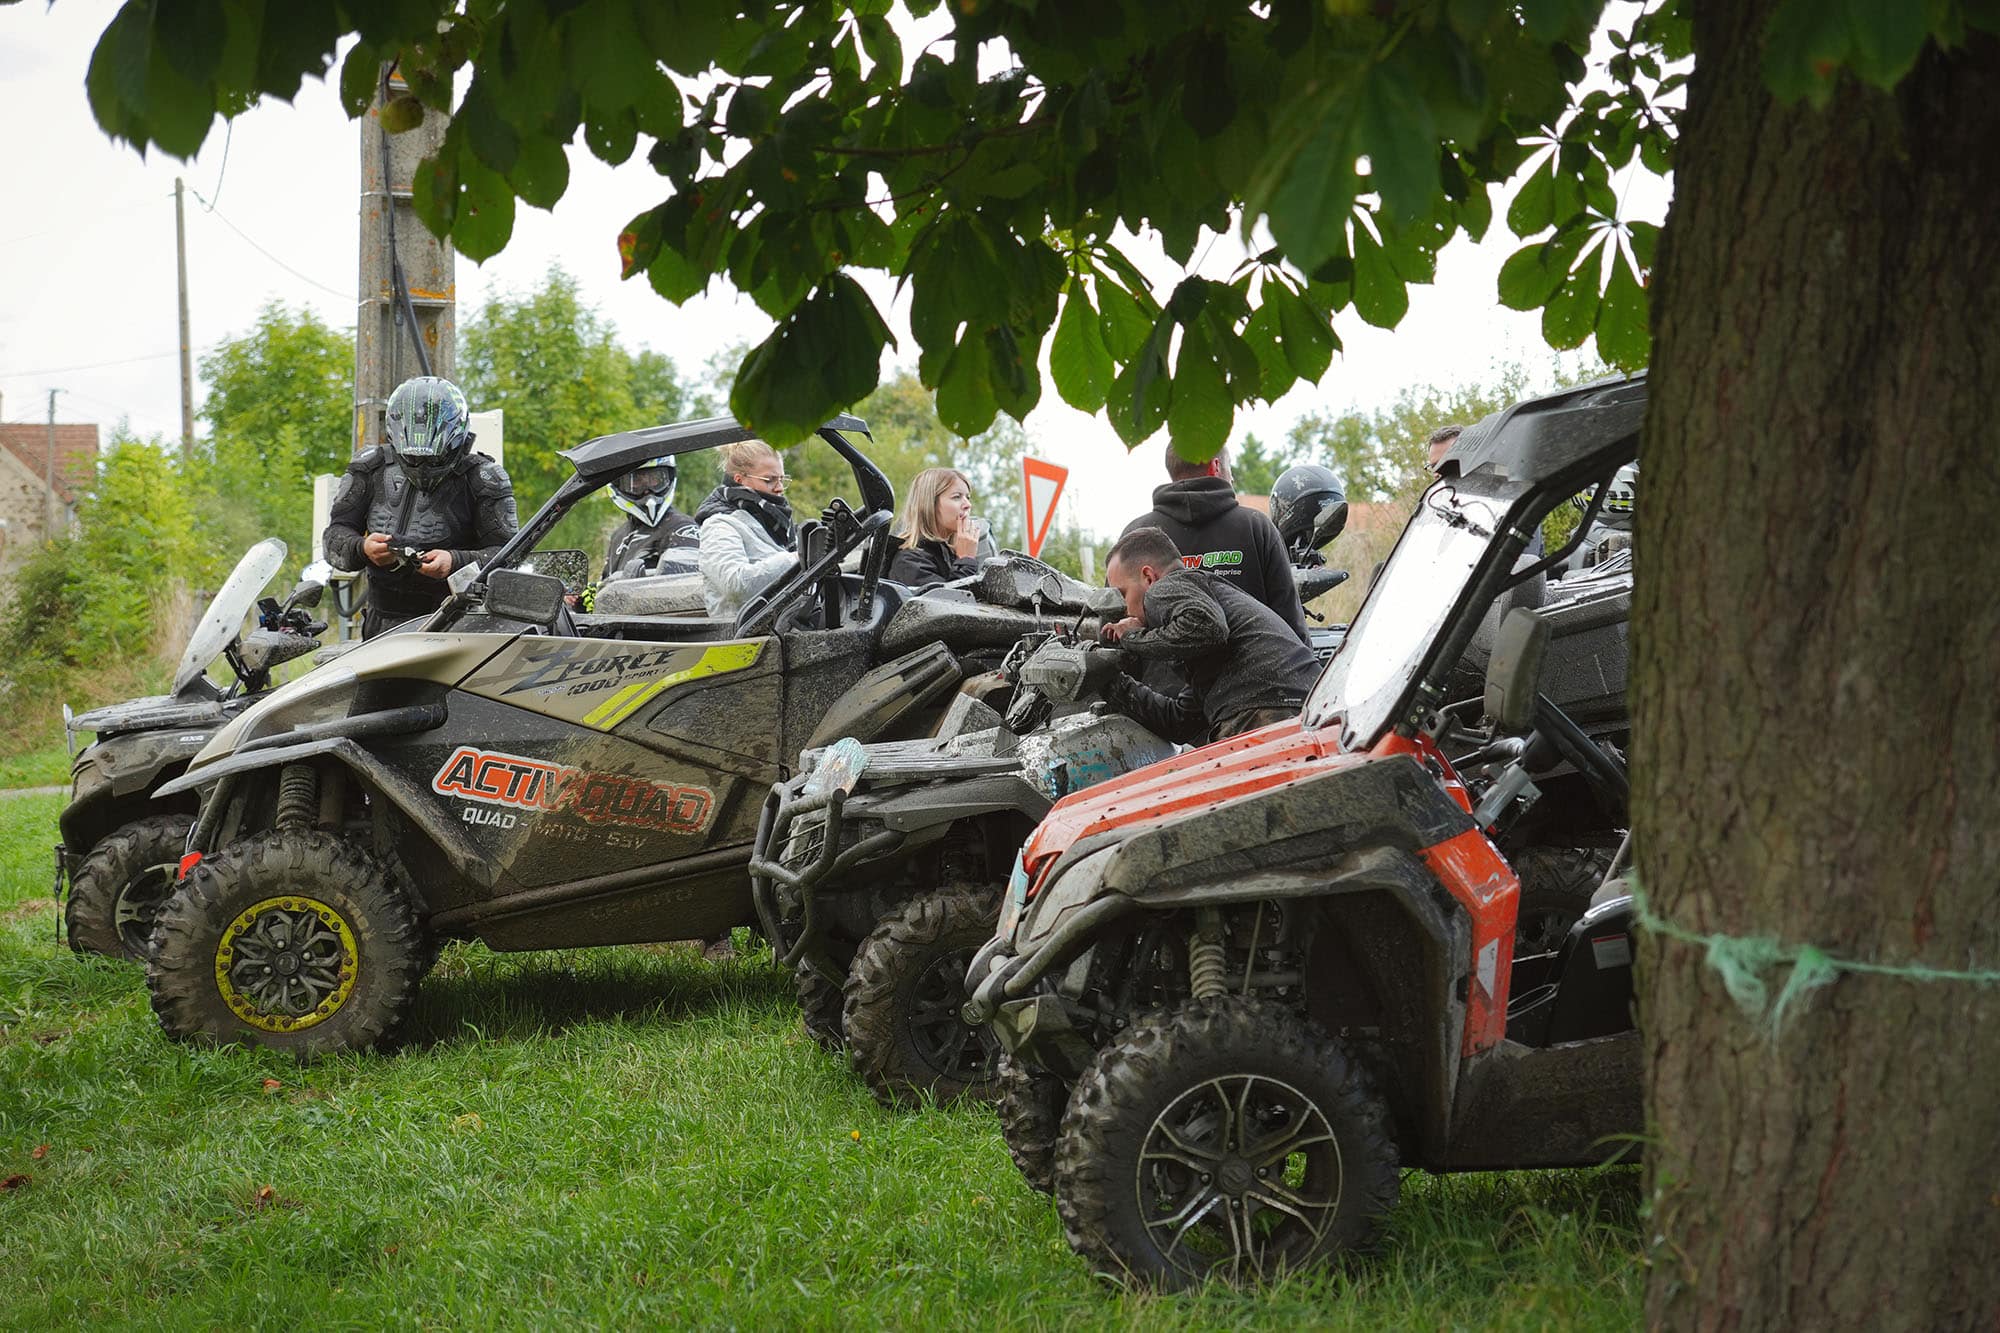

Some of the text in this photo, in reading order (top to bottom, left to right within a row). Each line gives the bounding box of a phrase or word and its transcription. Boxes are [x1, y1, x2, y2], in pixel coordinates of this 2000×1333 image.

[1181, 551, 1243, 570] TIV QUAD
[567, 676, 622, 696] 1000
[443, 755, 708, 825] ACTIV QUAD
[462, 807, 517, 829] QUAD
